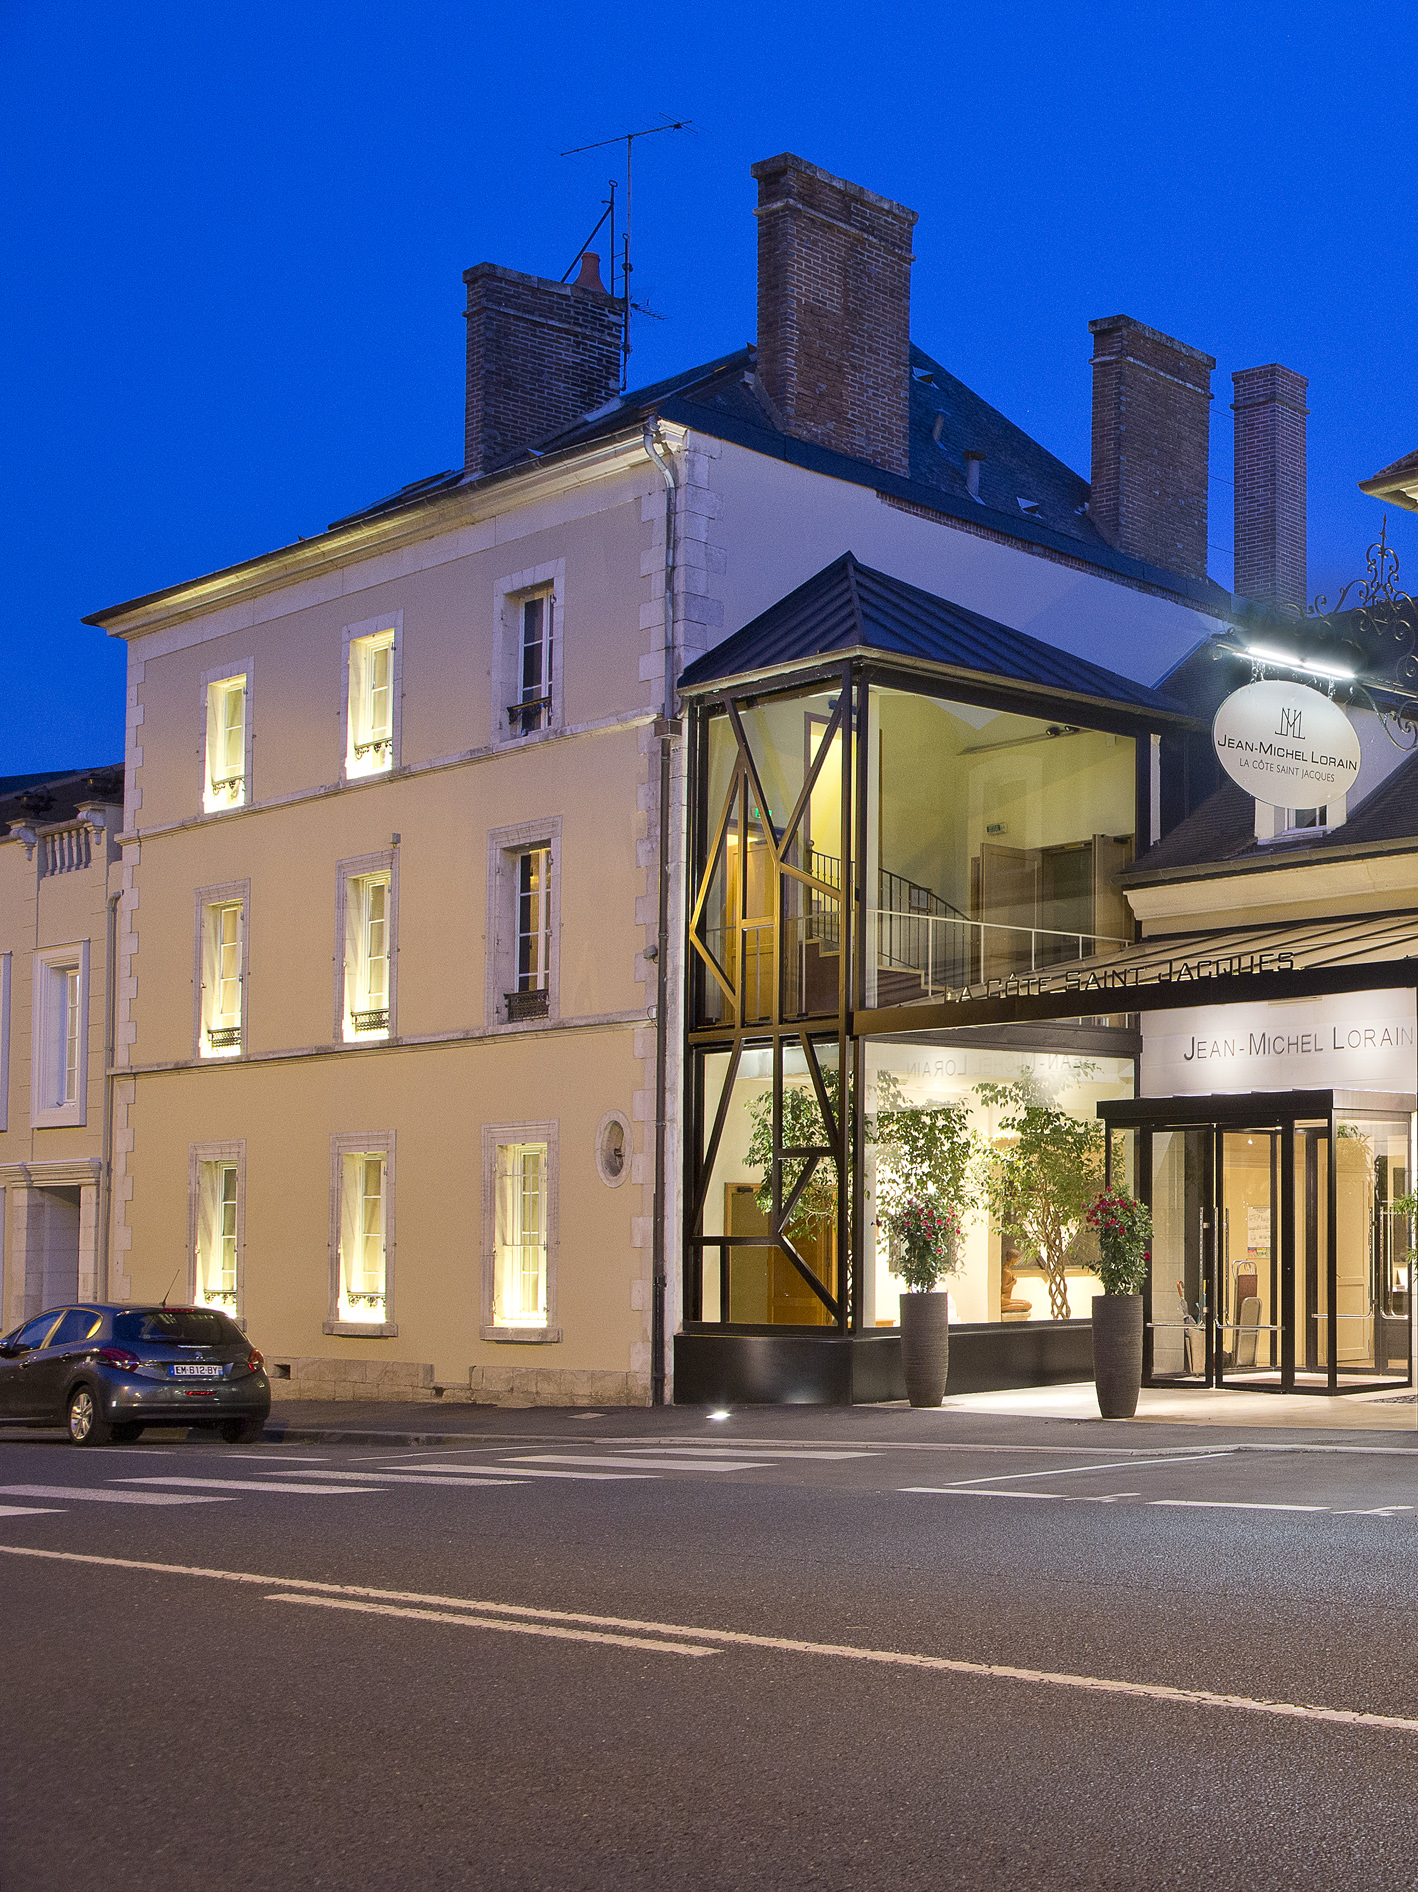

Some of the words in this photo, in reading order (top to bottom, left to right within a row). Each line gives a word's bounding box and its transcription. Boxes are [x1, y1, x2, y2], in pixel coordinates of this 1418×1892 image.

[1217, 734, 1308, 762] JEAN-MICHEL
[1311, 751, 1358, 771] LORAIN
[1239, 757, 1250, 768] LA
[1252, 759, 1274, 773] CÔTE
[1276, 764, 1300, 776] SAINT
[1301, 768, 1335, 783] JACQUES
[1065, 967, 1146, 991] SAINT
[1158, 952, 1294, 982] JACQUES
[1333, 1026, 1414, 1050] LORAIN
